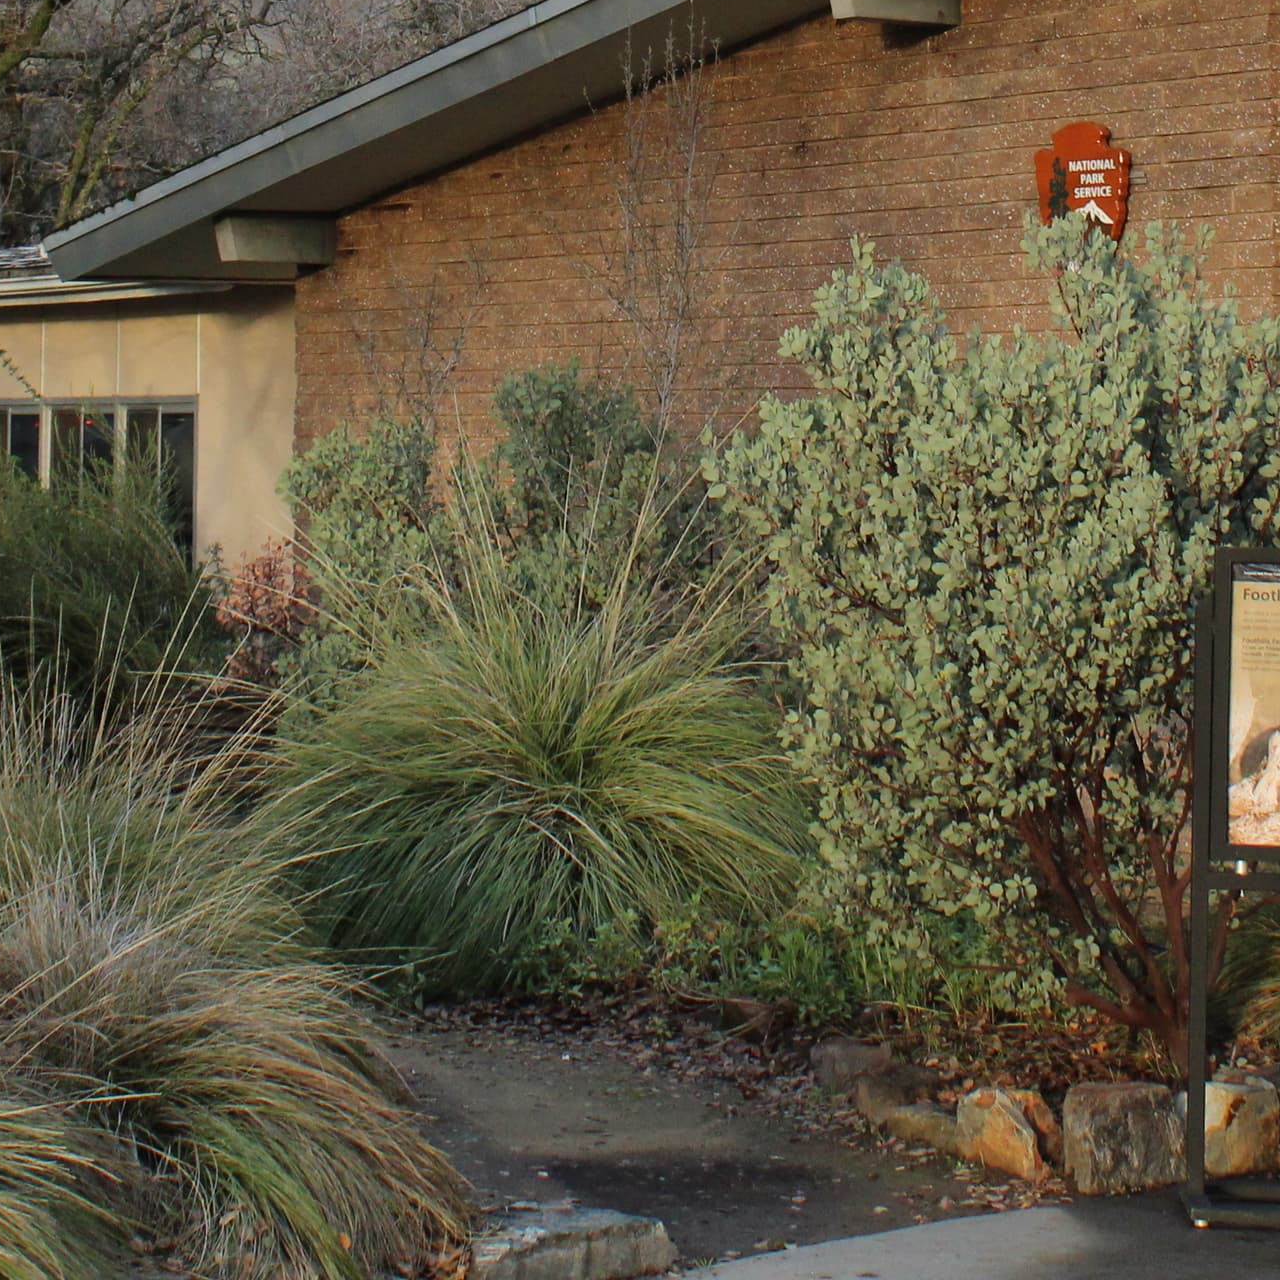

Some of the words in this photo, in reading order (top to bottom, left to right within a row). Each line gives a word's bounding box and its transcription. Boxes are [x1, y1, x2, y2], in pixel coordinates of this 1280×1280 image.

[1069, 159, 1115, 171] NATIONAL
[1080, 173, 1105, 185] PARK
[1074, 186, 1112, 199] SERVICE
